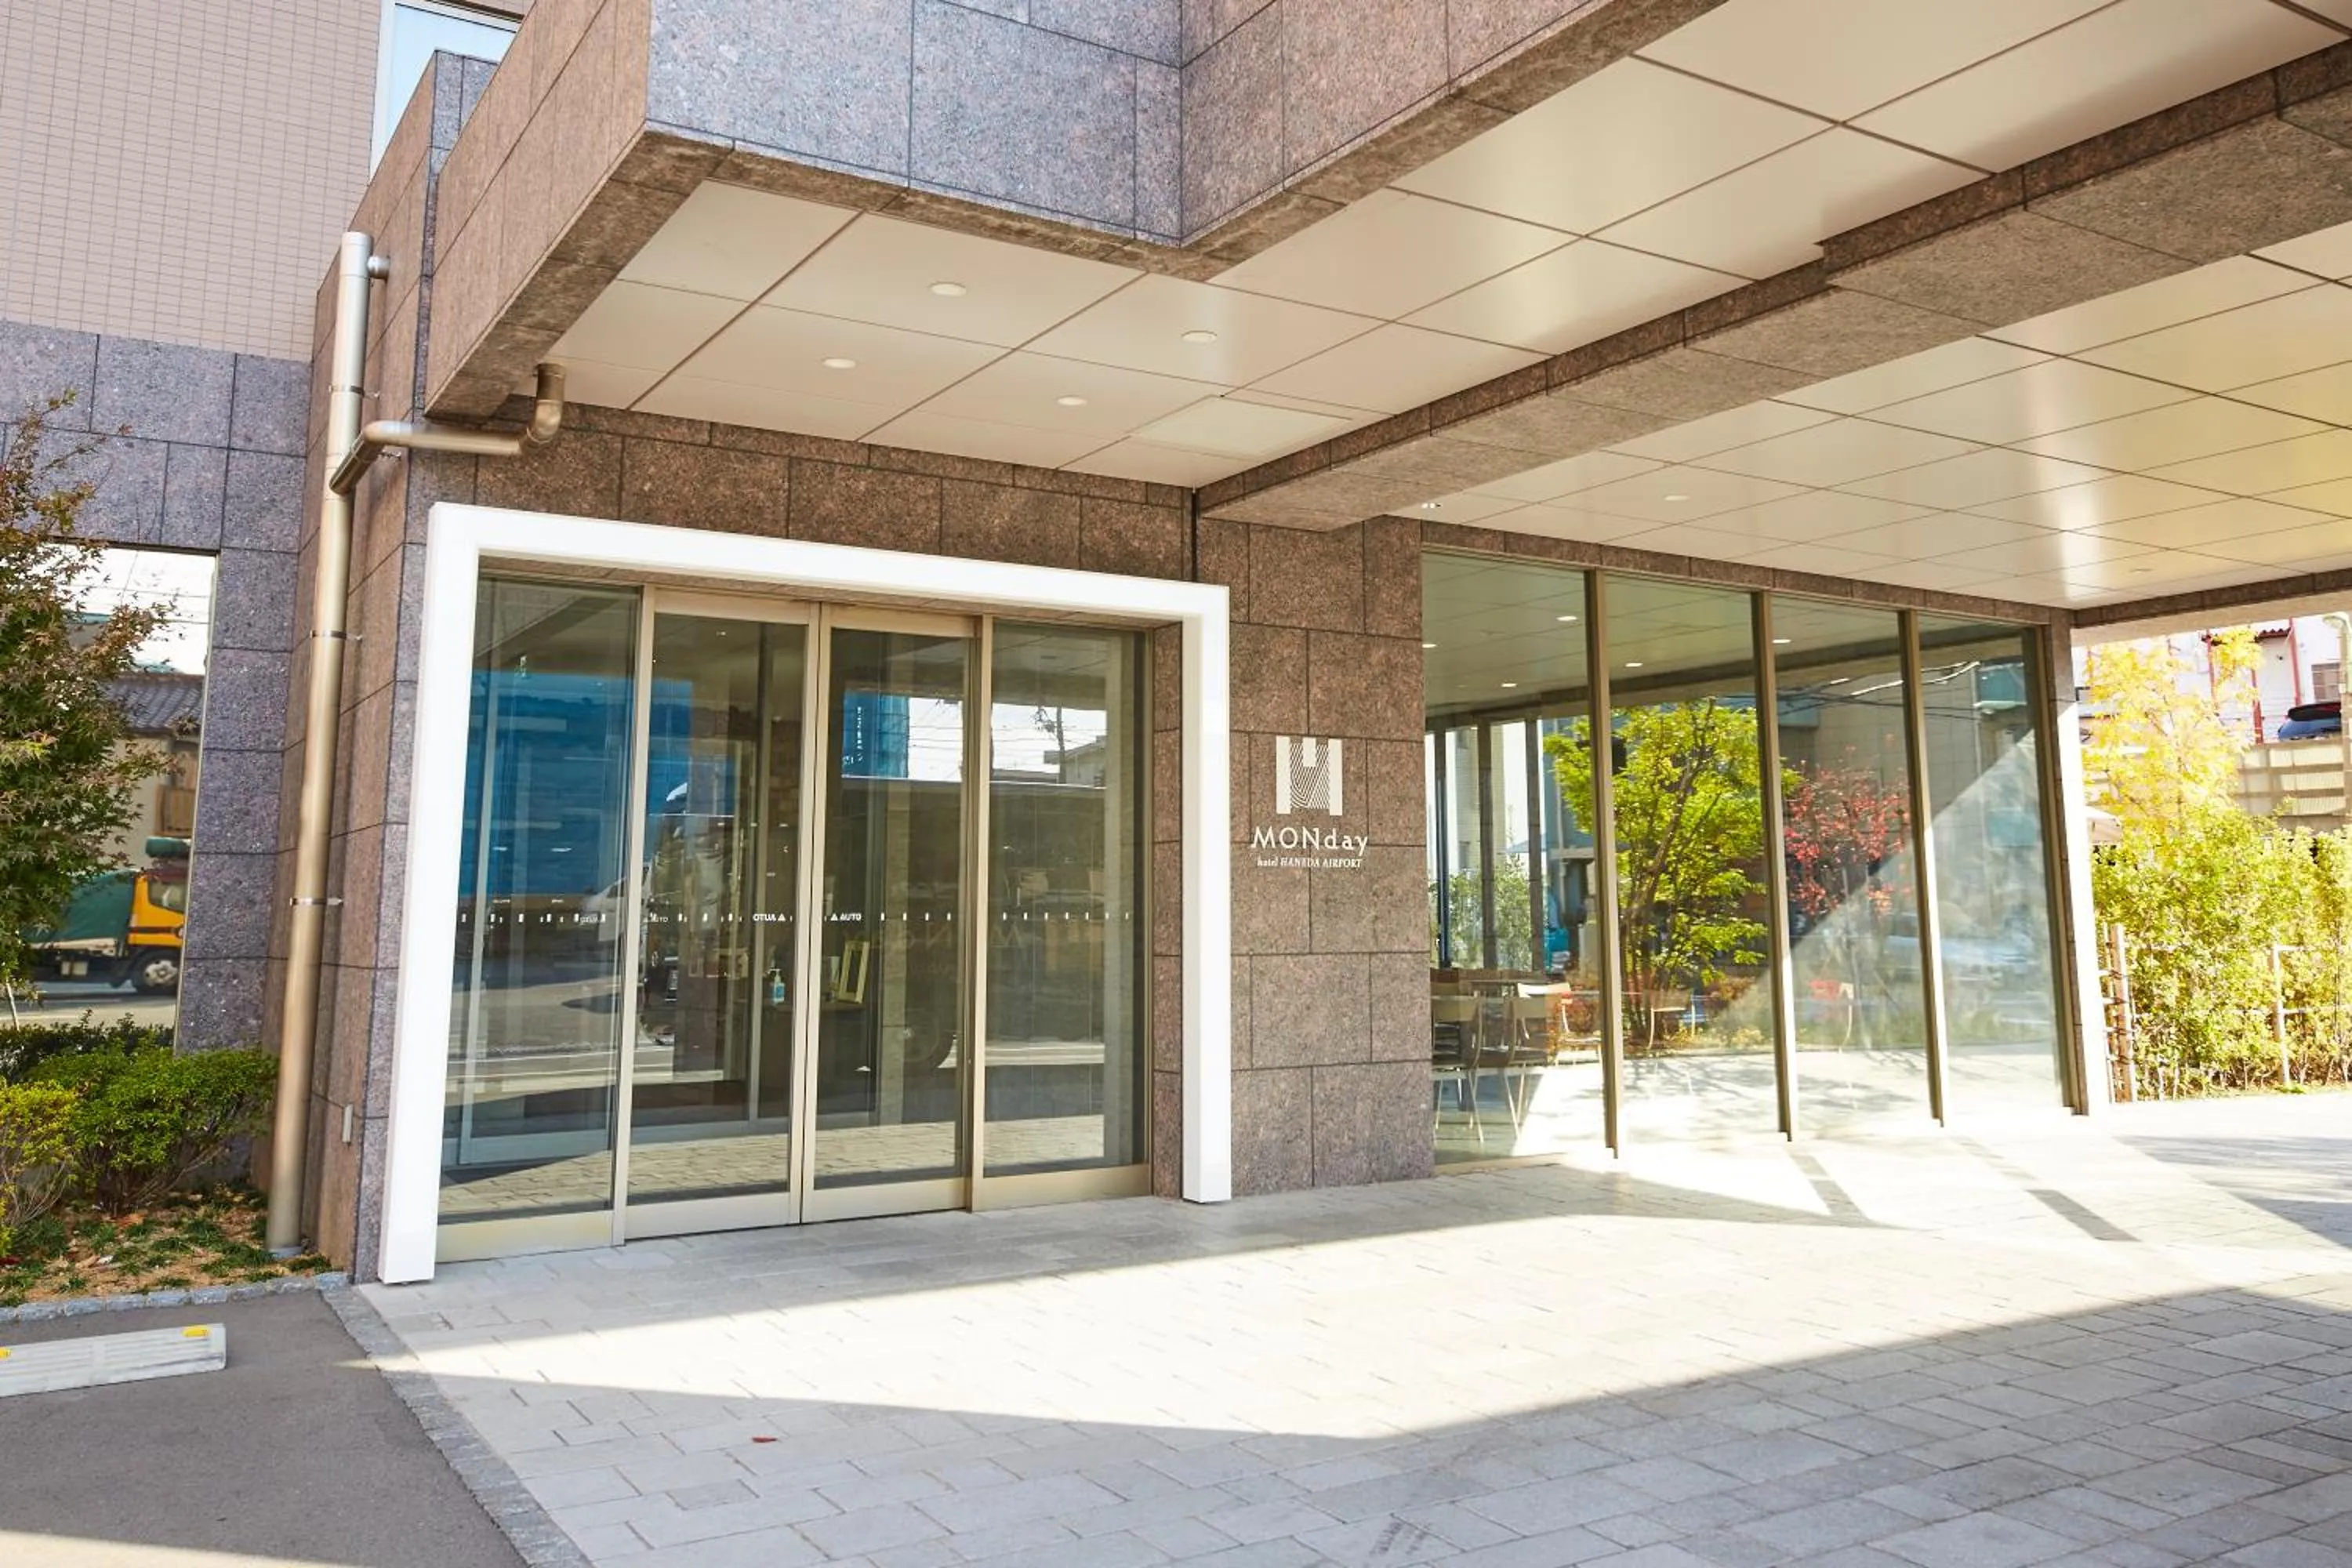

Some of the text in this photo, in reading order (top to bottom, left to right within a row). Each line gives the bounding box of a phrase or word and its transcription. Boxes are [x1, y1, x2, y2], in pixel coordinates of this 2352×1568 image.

[1250, 826, 1368, 856] MONday
[1257, 855, 1363, 868] hotel HANEDA AIRPORT
[840, 913, 862, 921] AUTO
